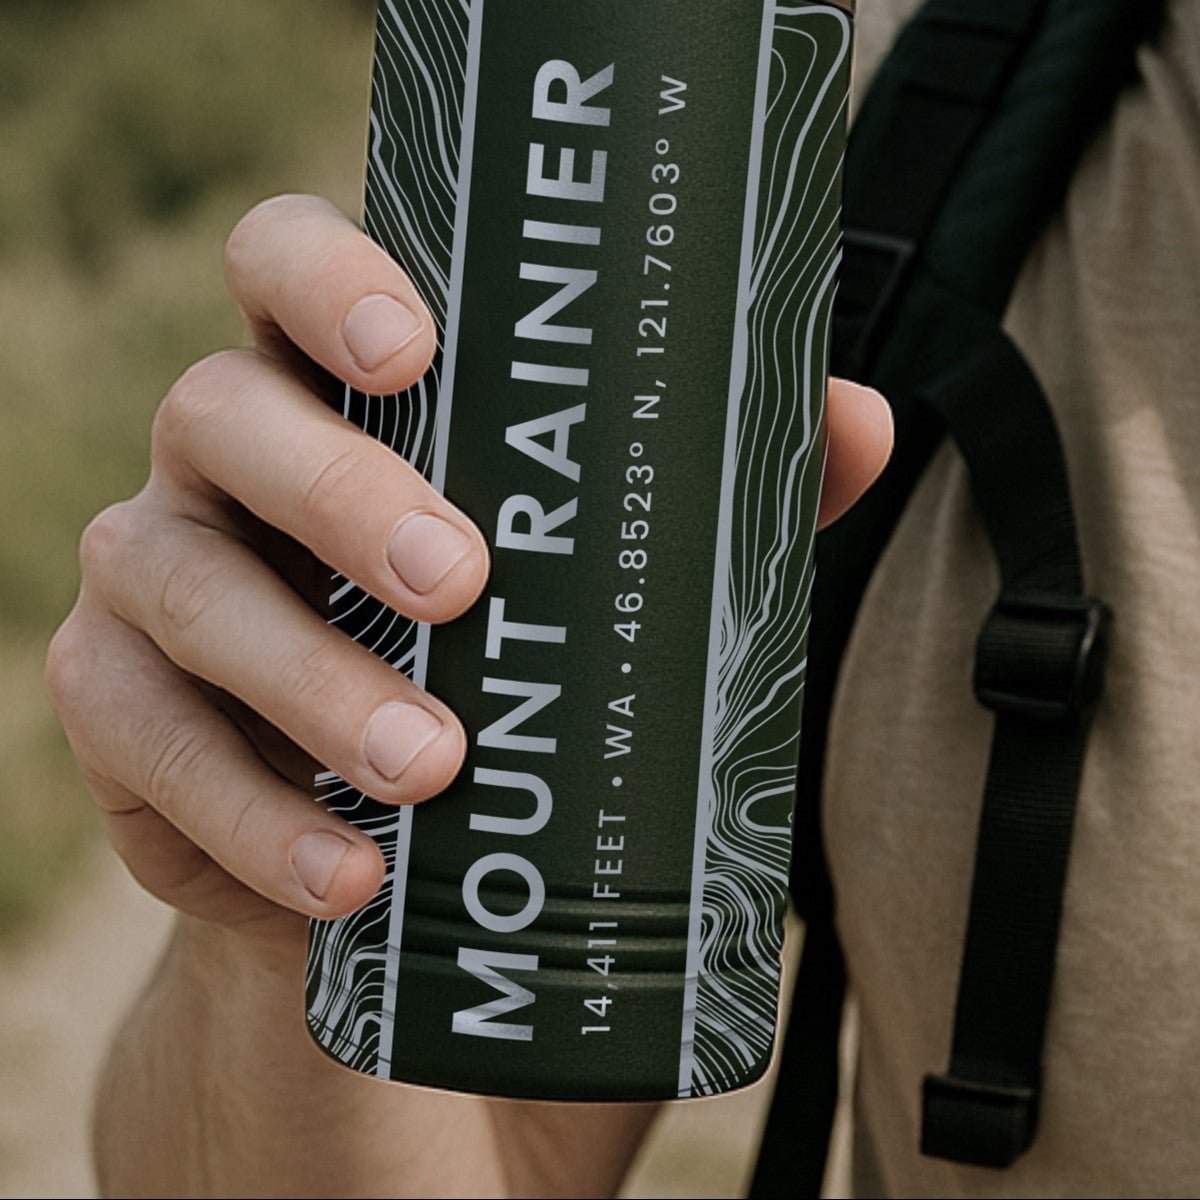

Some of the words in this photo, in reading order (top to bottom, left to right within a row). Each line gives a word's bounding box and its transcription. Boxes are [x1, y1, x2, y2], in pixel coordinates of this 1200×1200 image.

[658, 74, 688, 115] W
[636, 138, 680, 357] 121.7603°
[495, 59, 614, 555] RAINIER
[632, 379, 667, 419] N,
[613, 441, 654, 643] 46.8523°
[604, 694, 636, 760] WA
[452, 597, 567, 1041] MOUNT
[593, 809, 626, 898] FEET
[581, 922, 618, 1035] 14,411
